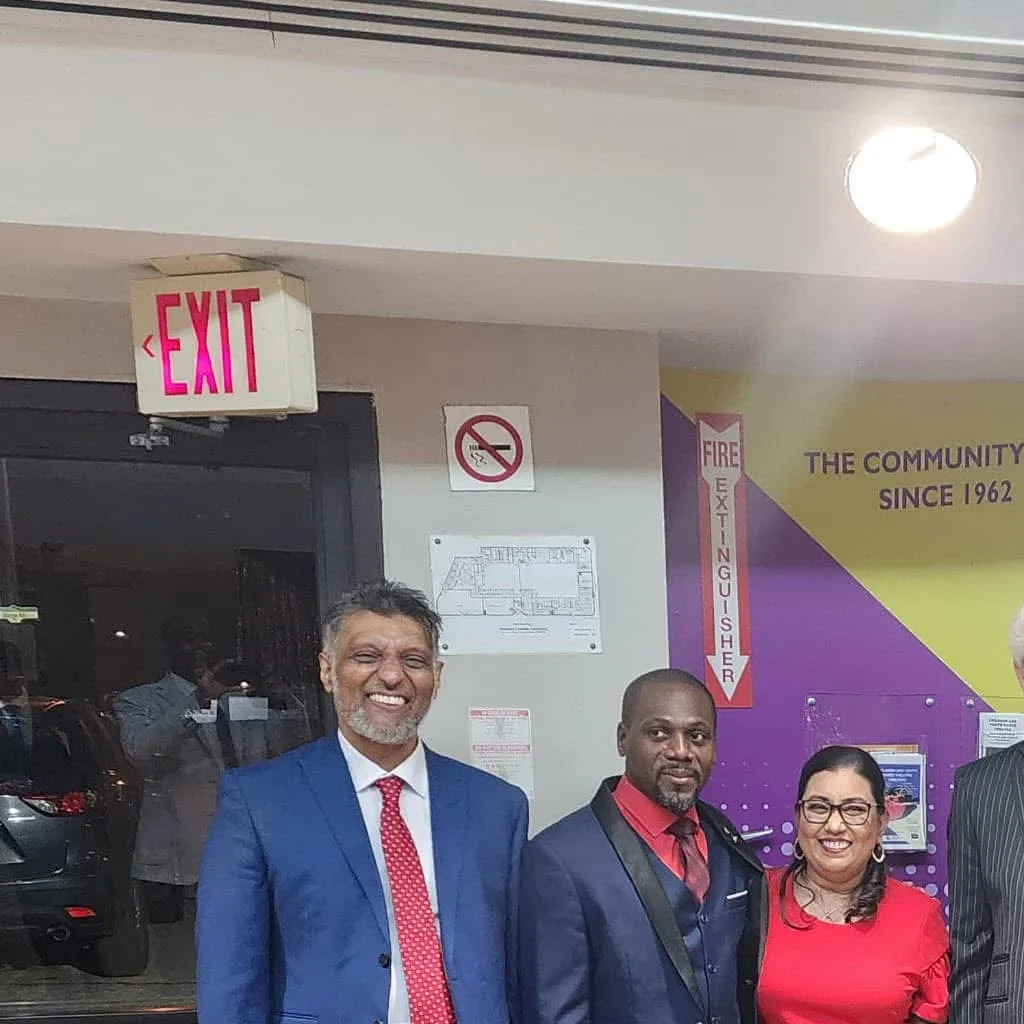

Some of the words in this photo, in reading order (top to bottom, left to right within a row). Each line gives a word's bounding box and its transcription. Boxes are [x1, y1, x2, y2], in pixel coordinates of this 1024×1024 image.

[156, 287, 260, 396] EXIT
[702, 440, 740, 469] FIRE
[803, 451, 856, 475] THE
[878, 483, 954, 511] SINCE
[964, 479, 1013, 505] 1962
[715, 477, 735, 683] EXTINGUISHER
